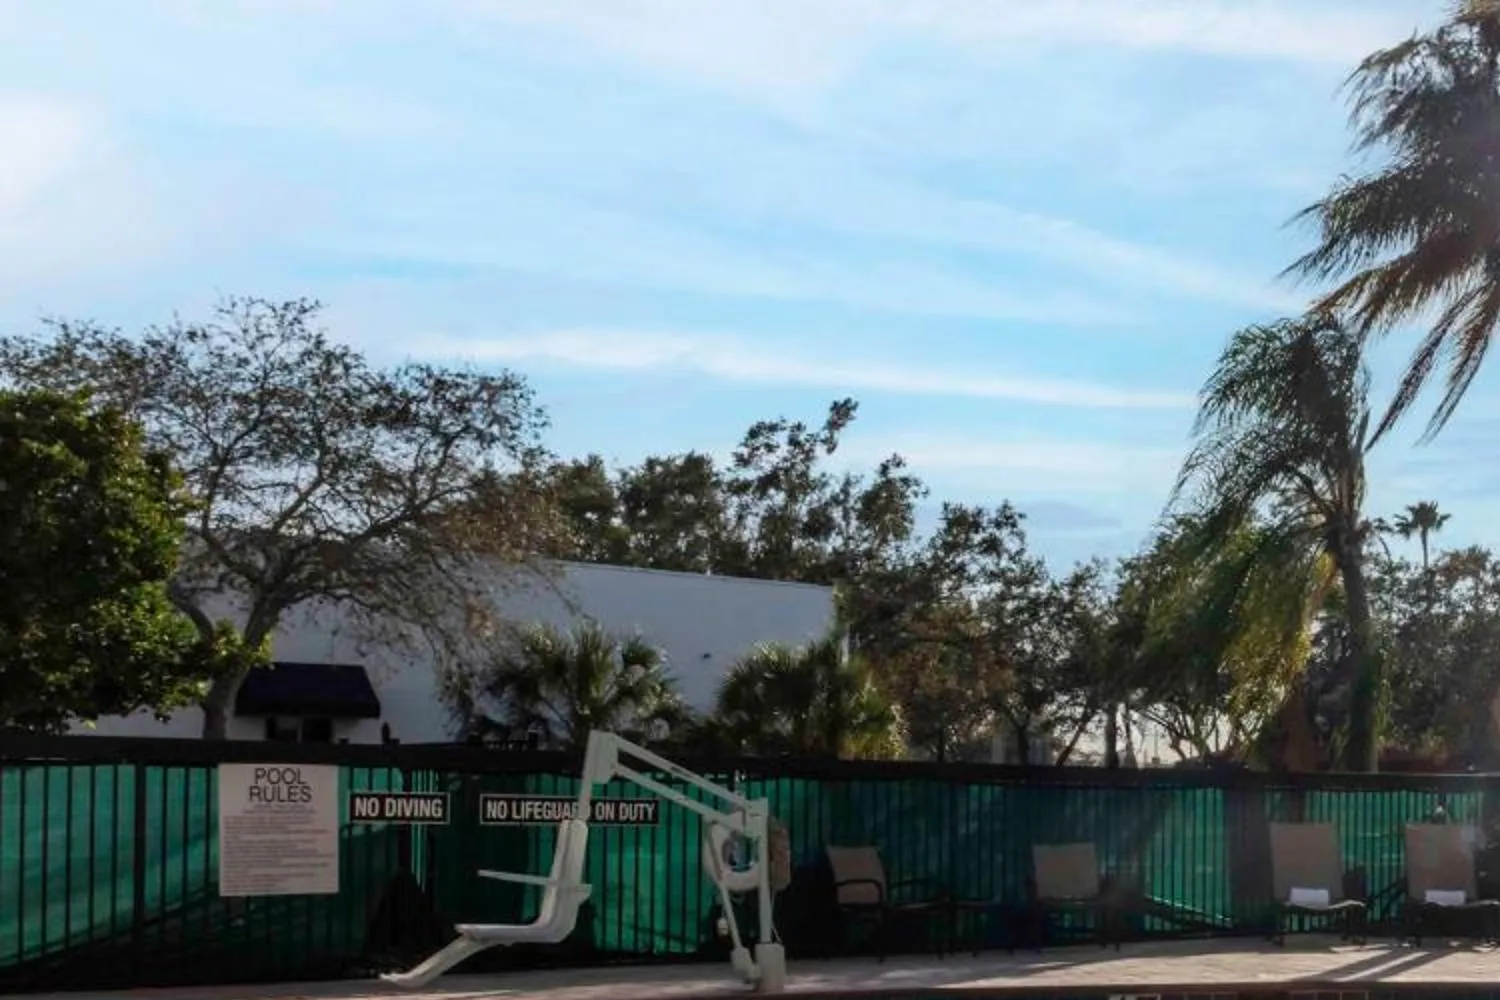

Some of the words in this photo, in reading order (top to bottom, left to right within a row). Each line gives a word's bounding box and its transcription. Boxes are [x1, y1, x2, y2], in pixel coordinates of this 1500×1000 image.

[254, 767, 307, 785] POOL
[248, 785, 313, 803] RULES
[354, 797, 380, 817] NO
[385, 797, 443, 817] DIVING
[486, 800, 508, 820] NO
[512, 800, 591, 820] LIFEGUAR
[595, 802, 615, 821] ON
[619, 802, 656, 821] DUTY
